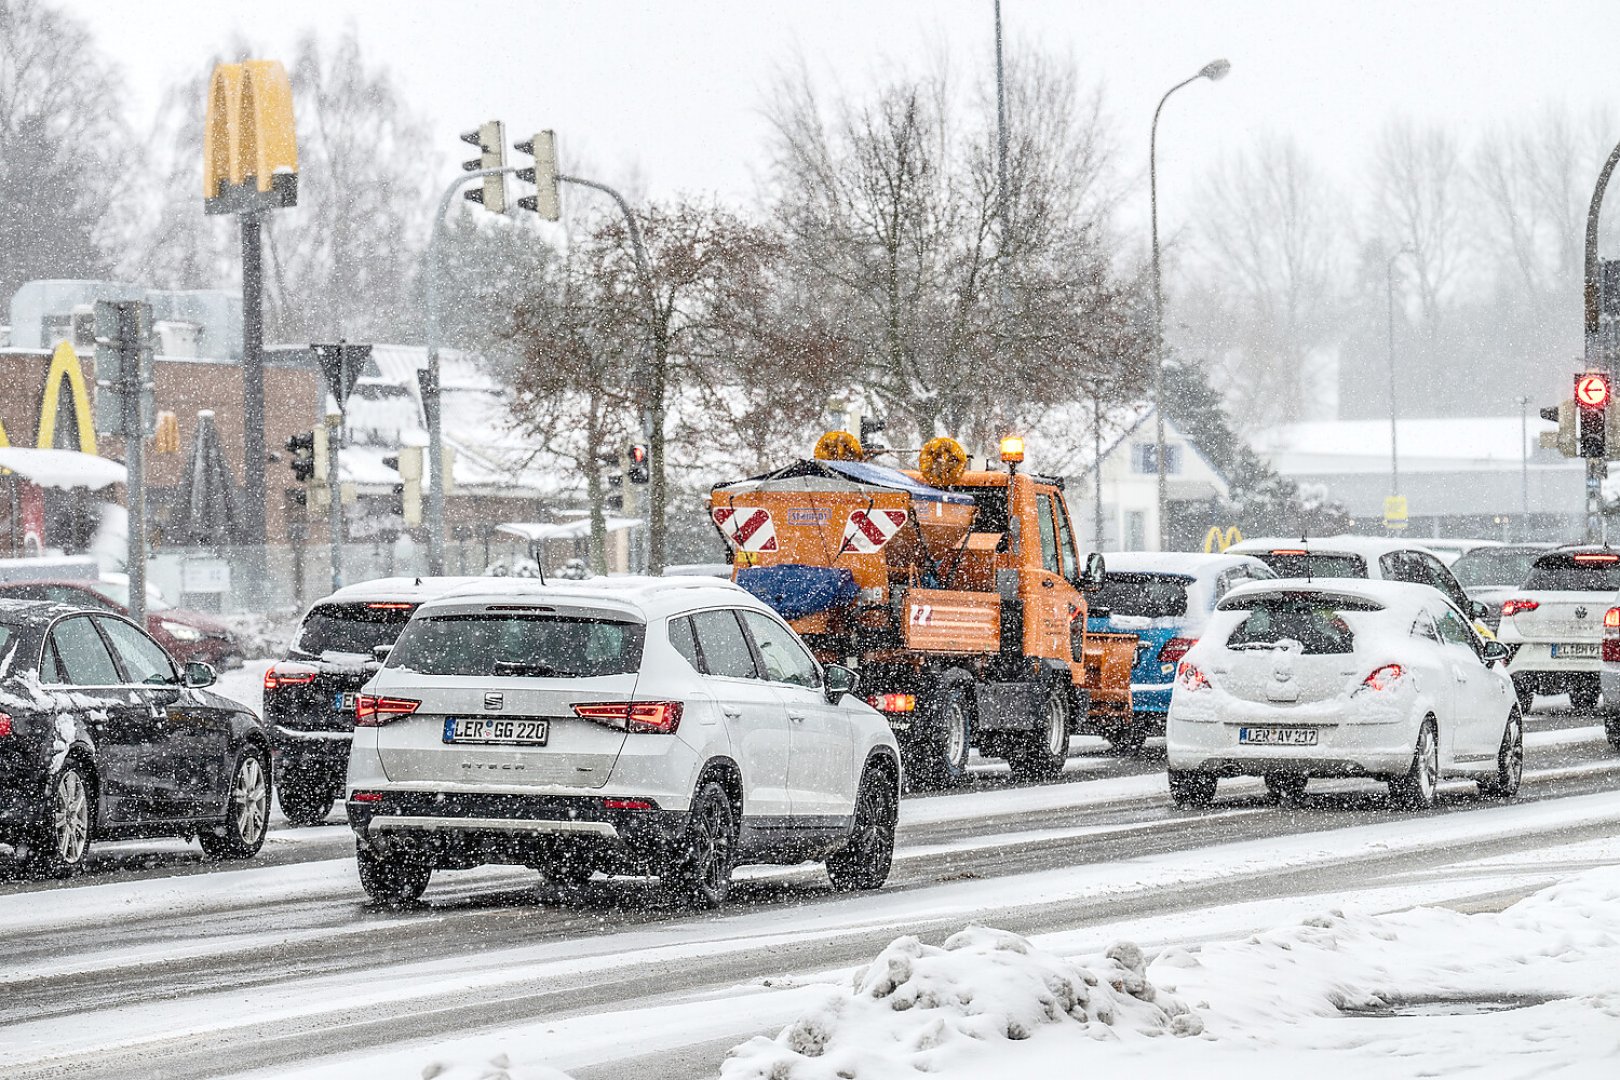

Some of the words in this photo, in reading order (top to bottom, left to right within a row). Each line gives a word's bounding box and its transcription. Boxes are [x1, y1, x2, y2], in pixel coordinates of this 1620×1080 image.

[454, 720, 484, 738] LER
[494, 721, 514, 739] GG
[516, 722, 545, 740] 220
[1247, 729, 1270, 742] LER
